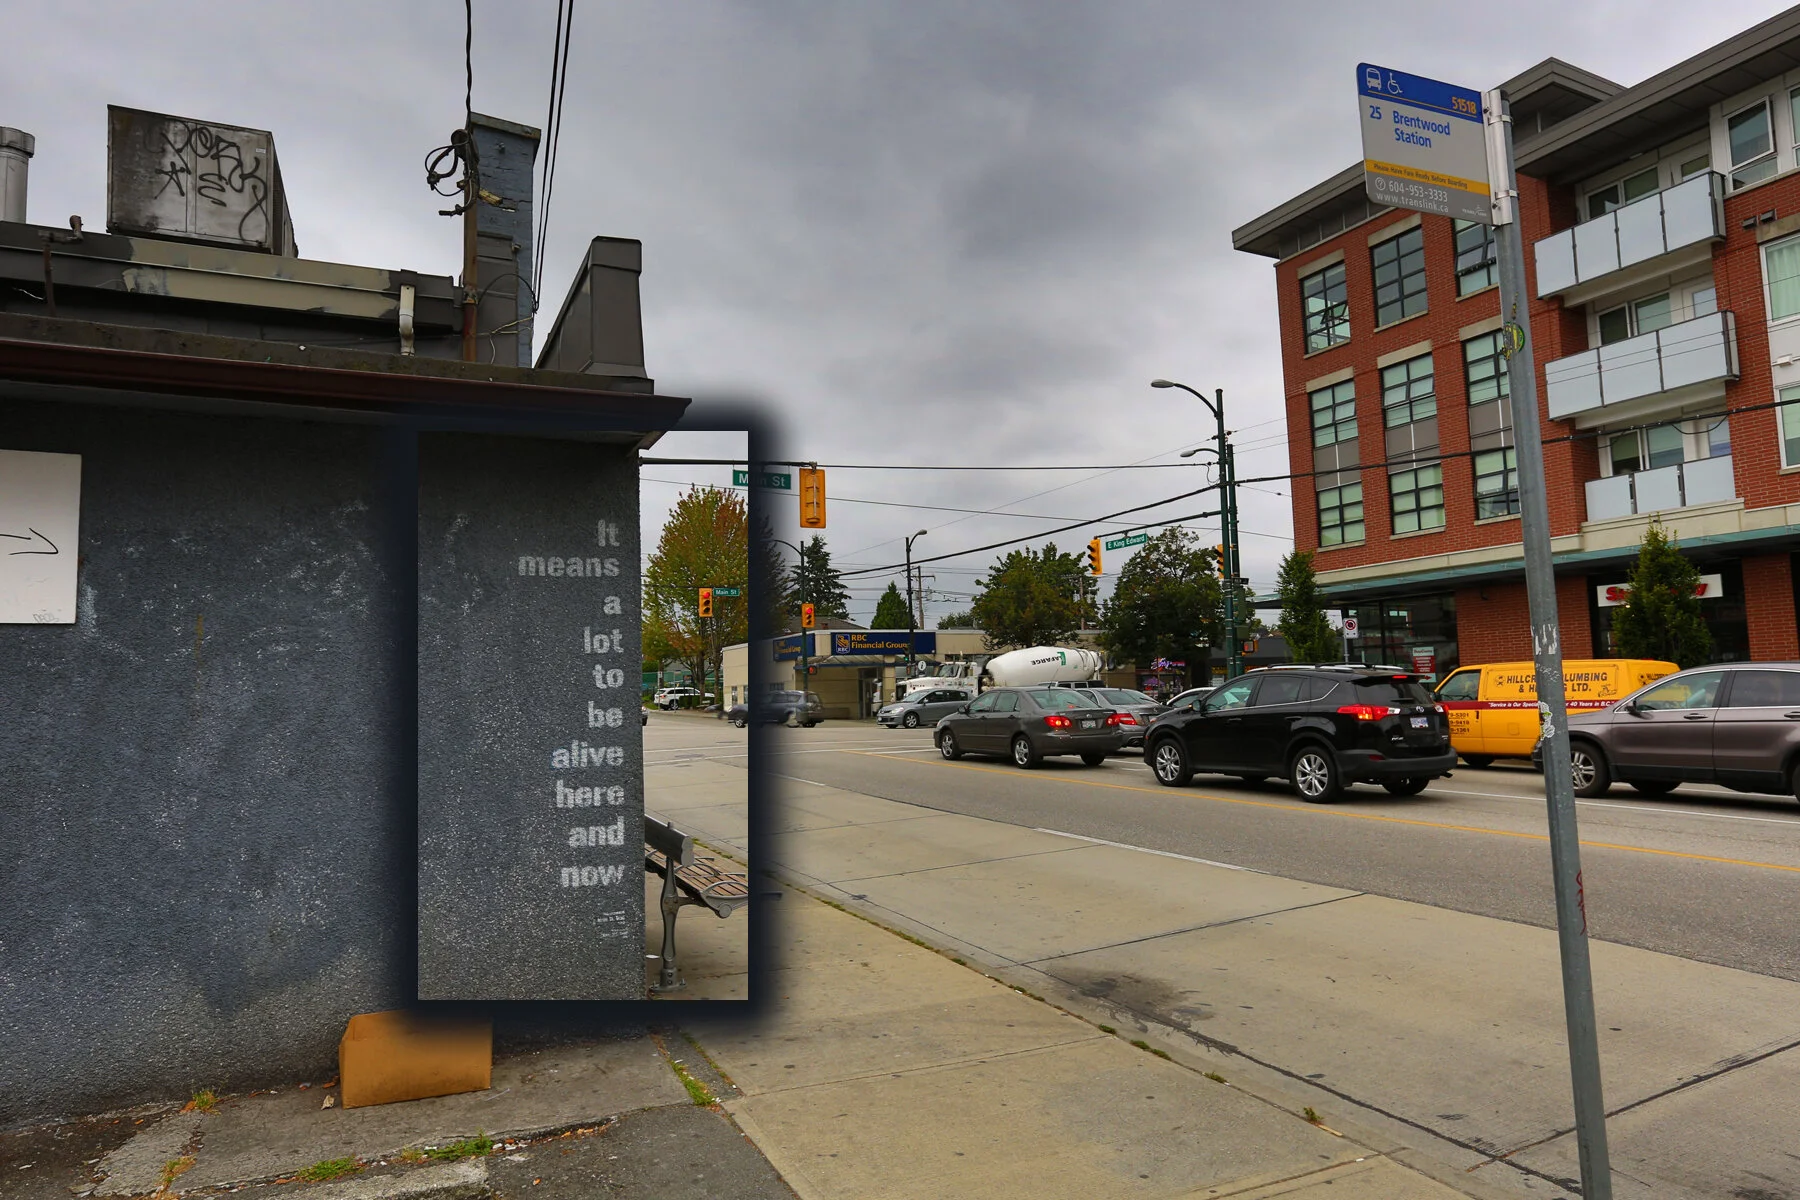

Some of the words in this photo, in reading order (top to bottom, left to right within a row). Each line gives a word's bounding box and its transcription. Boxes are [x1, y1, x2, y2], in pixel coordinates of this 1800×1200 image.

[1451, 97, 1477, 115] 51518
[1369, 105, 1382, 120] 25
[1392, 110, 1450, 136] Brentwood
[1394, 127, 1432, 148] Station
[1388, 180, 1448, 202] 604-953-3333
[1376, 193, 1449, 213] www.translink.ca
[771, 475, 786, 487] St
[597, 519, 620, 547] It
[1113, 540, 1125, 549] King
[1126, 534, 1145, 545] Edward
[518, 556, 620, 577] means
[603, 595, 621, 615] a
[584, 626, 624, 654] lot
[851, 641, 885, 649] Financial
[1030, 656, 1063, 666] LAFARGE
[592, 664, 624, 689] to
[1506, 674, 1537, 684] HILLCR
[1564, 671, 1608, 682] LUMBING
[1518, 684, 1525, 693] &
[1571, 682, 1592, 692] LTD.
[587, 700, 623, 728] be
[551, 739, 624, 769] alive
[555, 779, 625, 809] here
[568, 815, 625, 848] and
[560, 864, 625, 889] now
